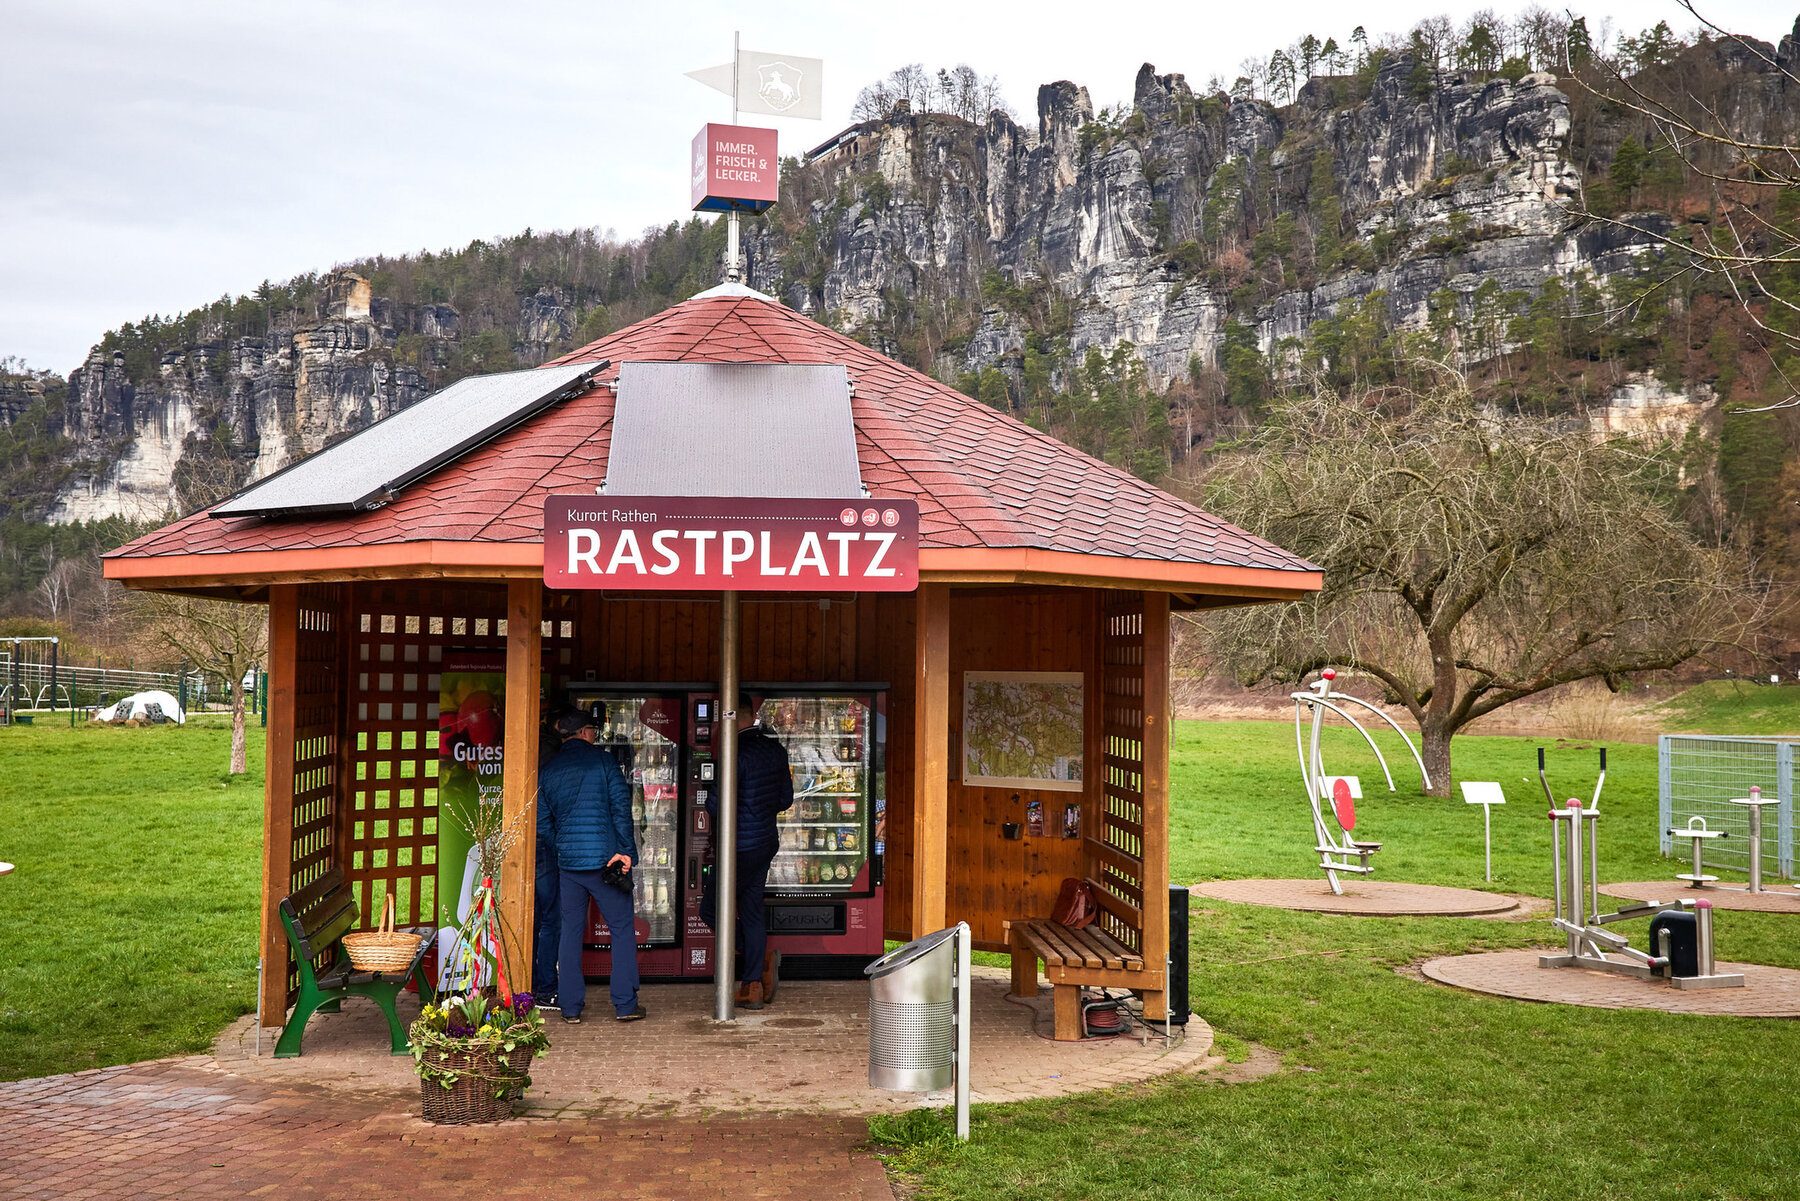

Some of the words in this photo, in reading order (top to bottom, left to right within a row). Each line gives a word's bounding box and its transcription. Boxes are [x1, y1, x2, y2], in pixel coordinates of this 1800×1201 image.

[716, 141, 758, 155] IMMER.
[716, 155, 755, 168] FRISCH
[759, 159, 768, 169] &
[716, 168, 761, 182] LECKER.
[567, 509, 608, 523] Kurort
[612, 509, 658, 523] Rathen
[567, 528, 898, 577] RASTPLATZ
[454, 742, 503, 762] Gutes
[478, 763, 502, 775] von
[479, 784, 501, 793] Kurze
